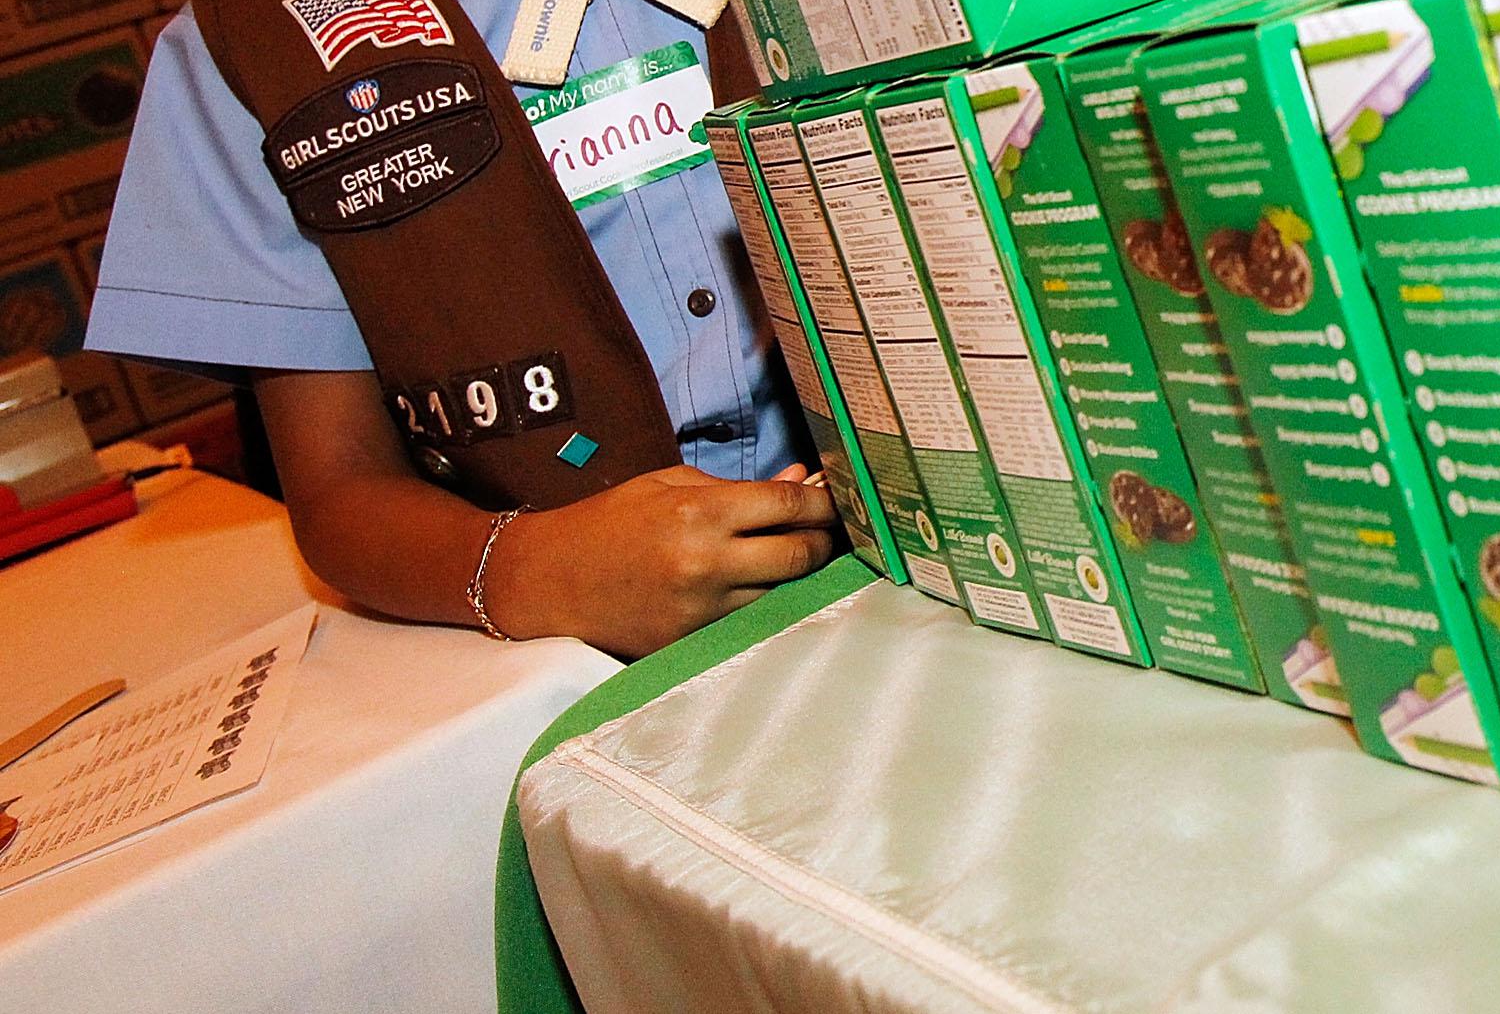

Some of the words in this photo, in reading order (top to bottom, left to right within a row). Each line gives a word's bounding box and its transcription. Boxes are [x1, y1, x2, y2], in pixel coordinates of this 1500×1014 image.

[280, 127, 330, 171] GIRL
[327, 93, 417, 150] SCOUTS
[421, 81, 475, 116] USA
[524, 98, 547, 121] o!
[549, 90, 578, 112] My
[800, 121, 837, 139] Nutrition
[838, 115, 863, 132] Facts
[336, 184, 384, 219] NEW
[391, 156, 455, 198] YORK
[340, 142, 436, 192] GREATER
[397, 365, 559, 436] 2198
